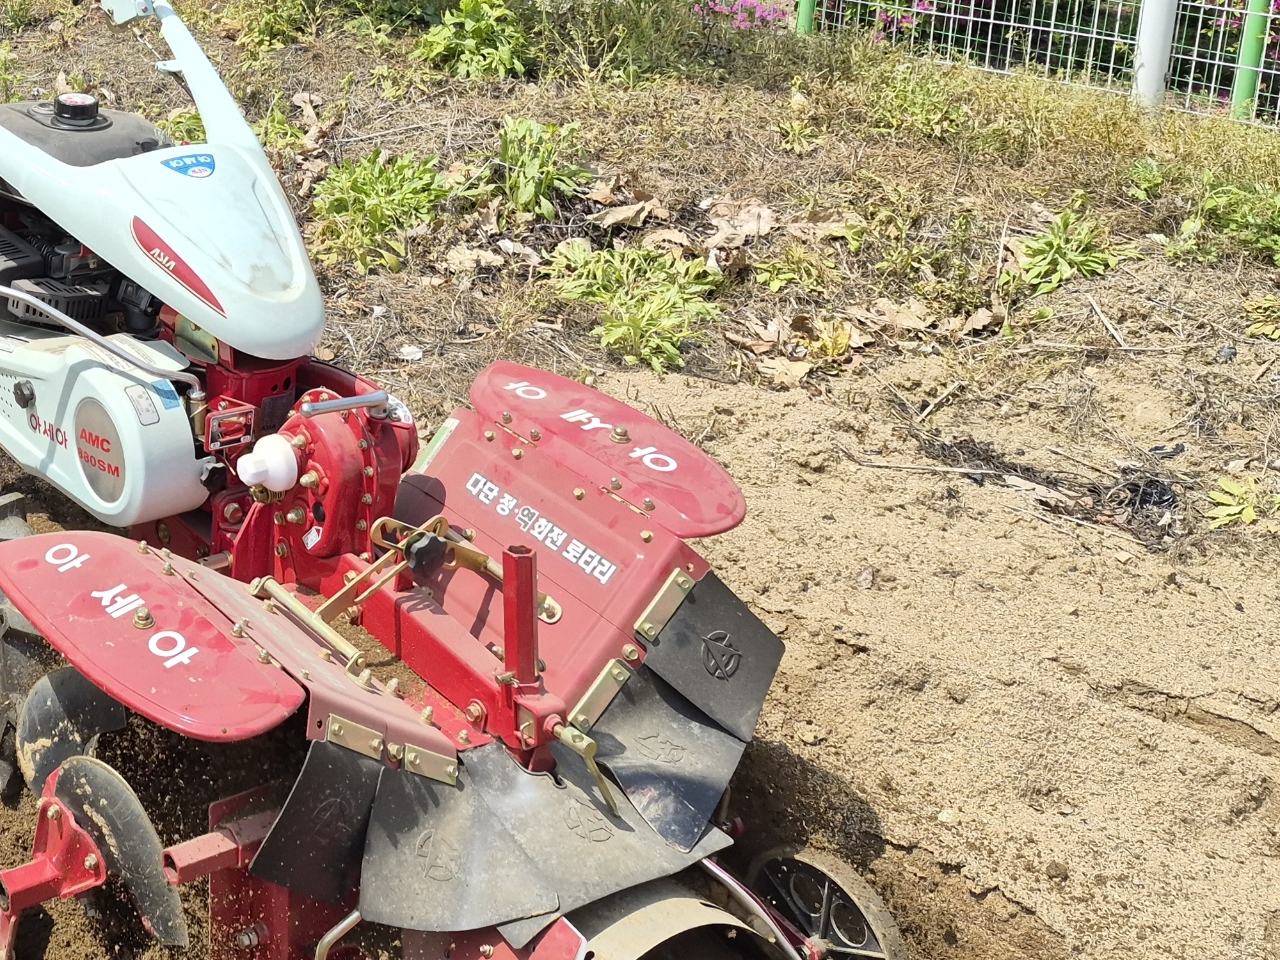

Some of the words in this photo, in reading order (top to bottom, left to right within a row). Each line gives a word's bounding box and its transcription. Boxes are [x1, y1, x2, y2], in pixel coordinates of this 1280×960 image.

[150, 247, 177, 271] ASIA
[29, 413, 68, 449] 아세아
[79, 427, 112, 453] AMC
[465, 472, 500, 505] 다단
[495, 492, 569, 552] 정·역회전
[562, 539, 618, 585] 로타리
[44, 543, 200, 669] 아세아
